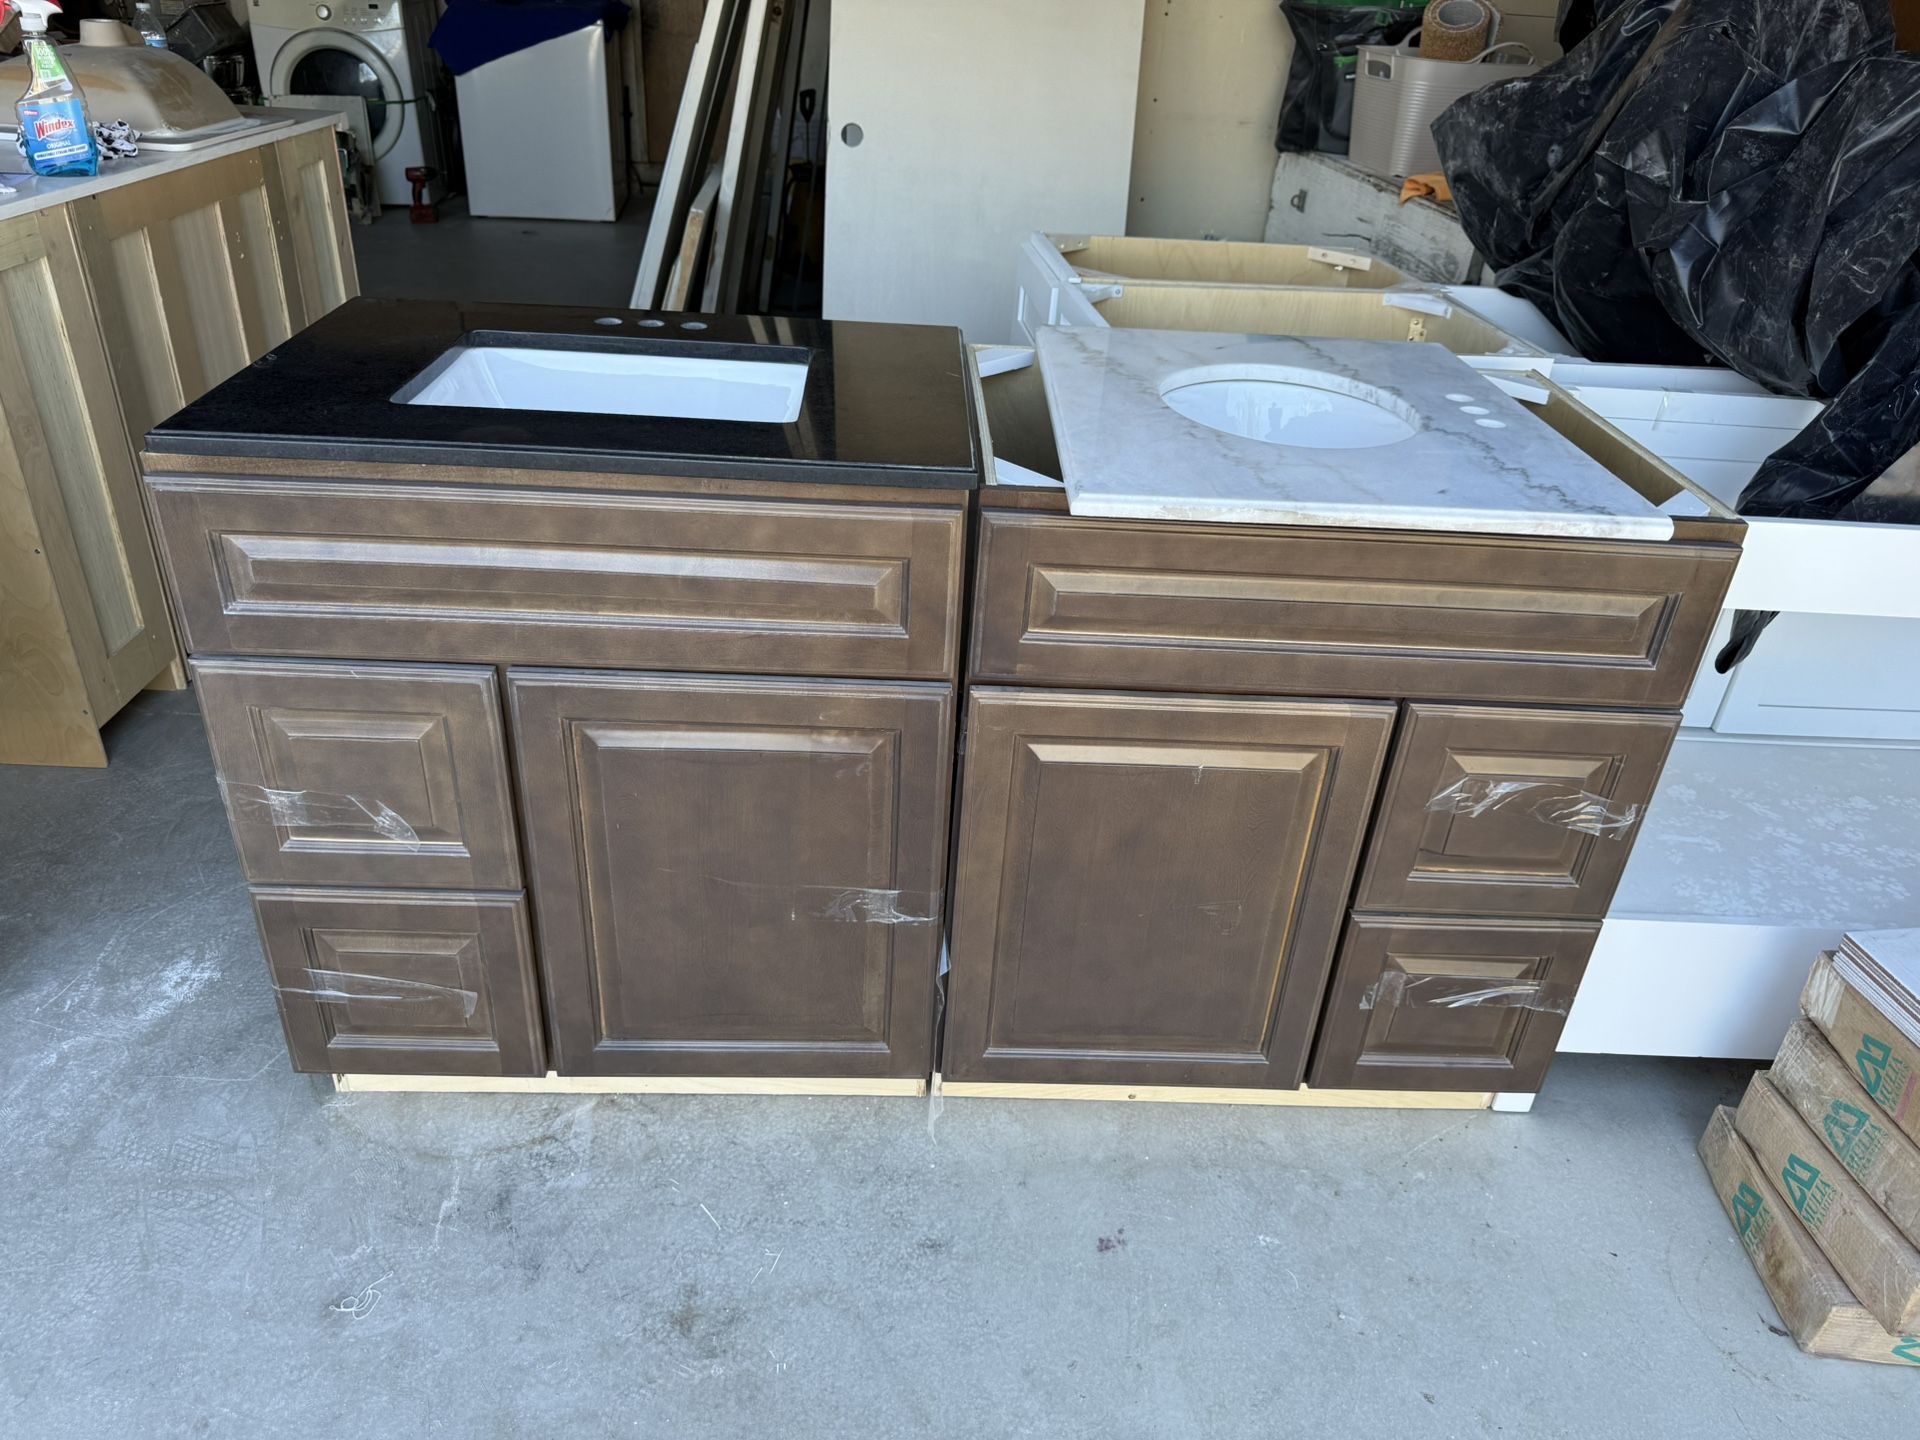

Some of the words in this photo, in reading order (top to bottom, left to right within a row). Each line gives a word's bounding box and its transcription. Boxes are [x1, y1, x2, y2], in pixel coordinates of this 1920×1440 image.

[34, 118, 75, 140] Windex
[46, 140, 72, 149] ORIGINAL
[1875, 1056, 1903, 1105] MULIA
[1802, 1179, 1832, 1224] MULIA
